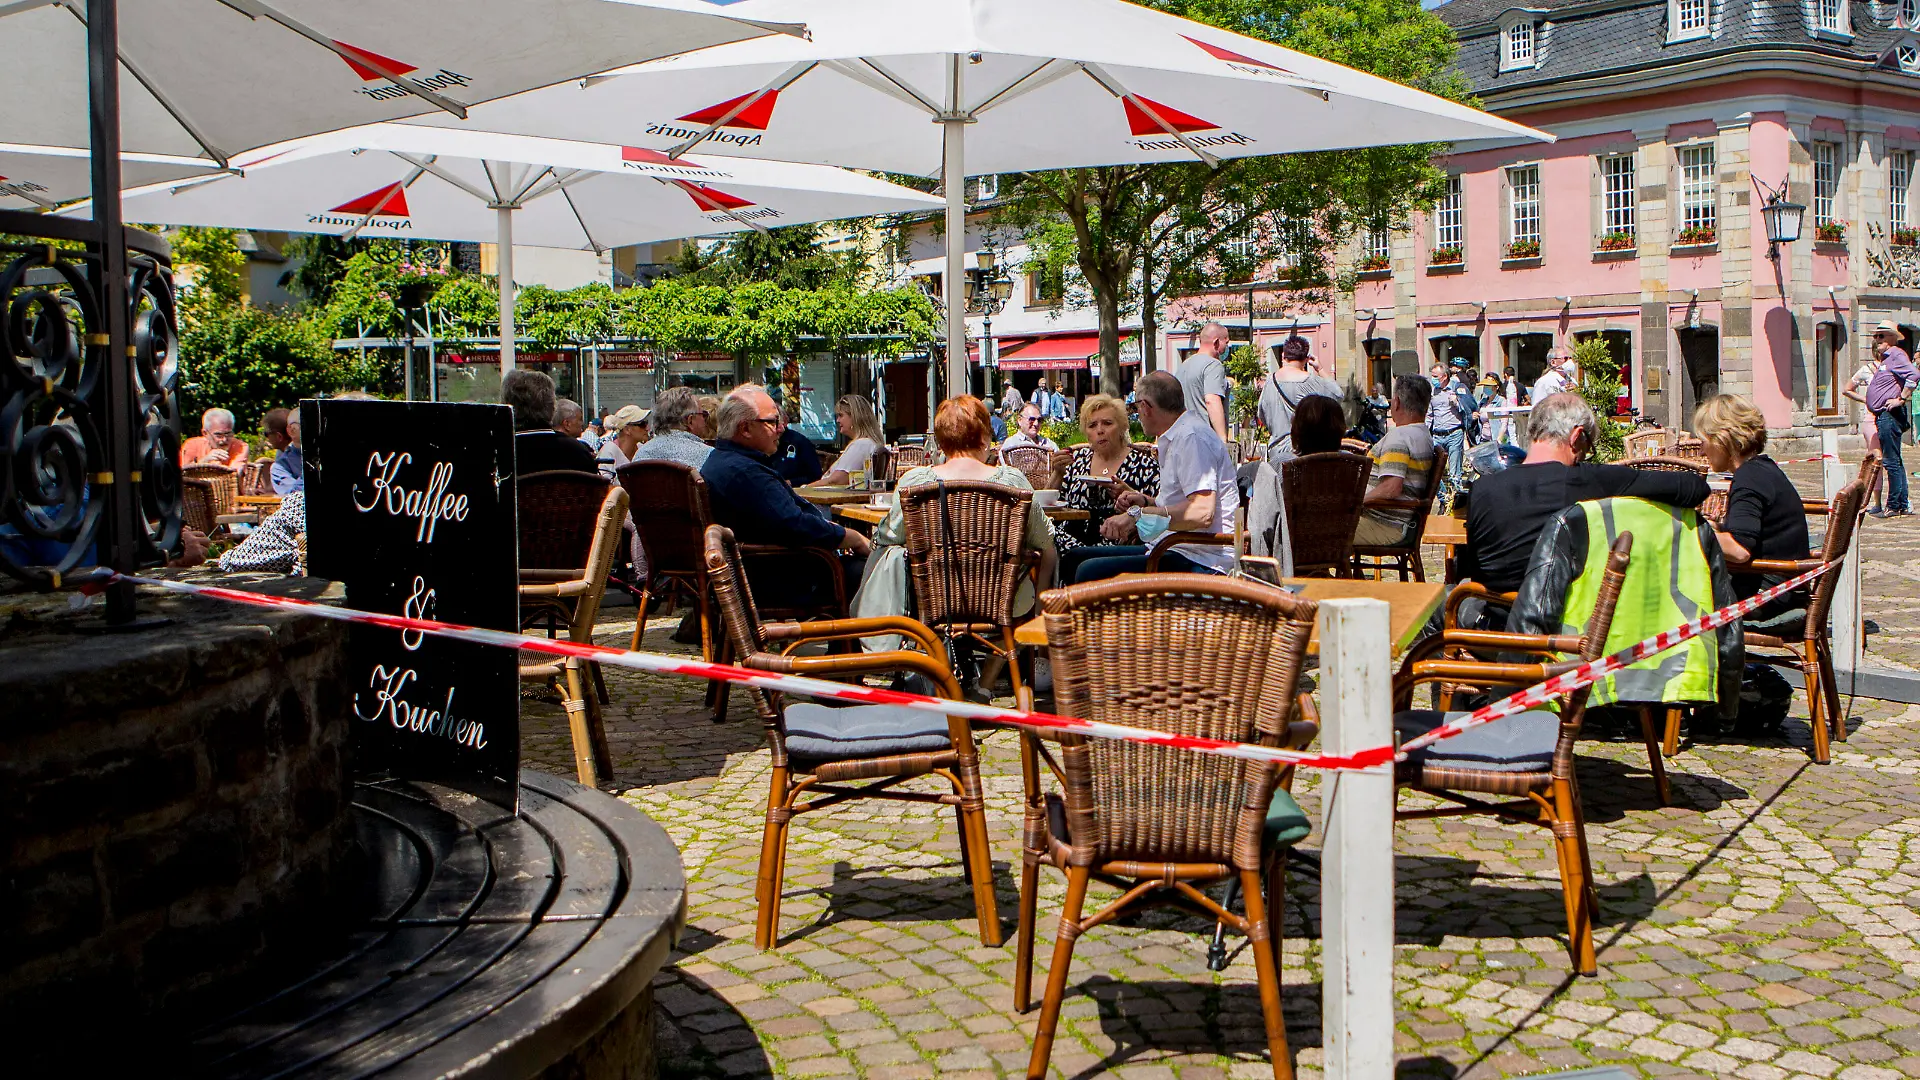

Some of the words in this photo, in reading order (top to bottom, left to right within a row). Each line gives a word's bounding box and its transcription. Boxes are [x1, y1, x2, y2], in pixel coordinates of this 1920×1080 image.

[623, 161, 734, 178] Apollinaris
[353, 451, 470, 543] Kaffee
[402, 576, 437, 651] &
[354, 664, 488, 750] Kuchen
